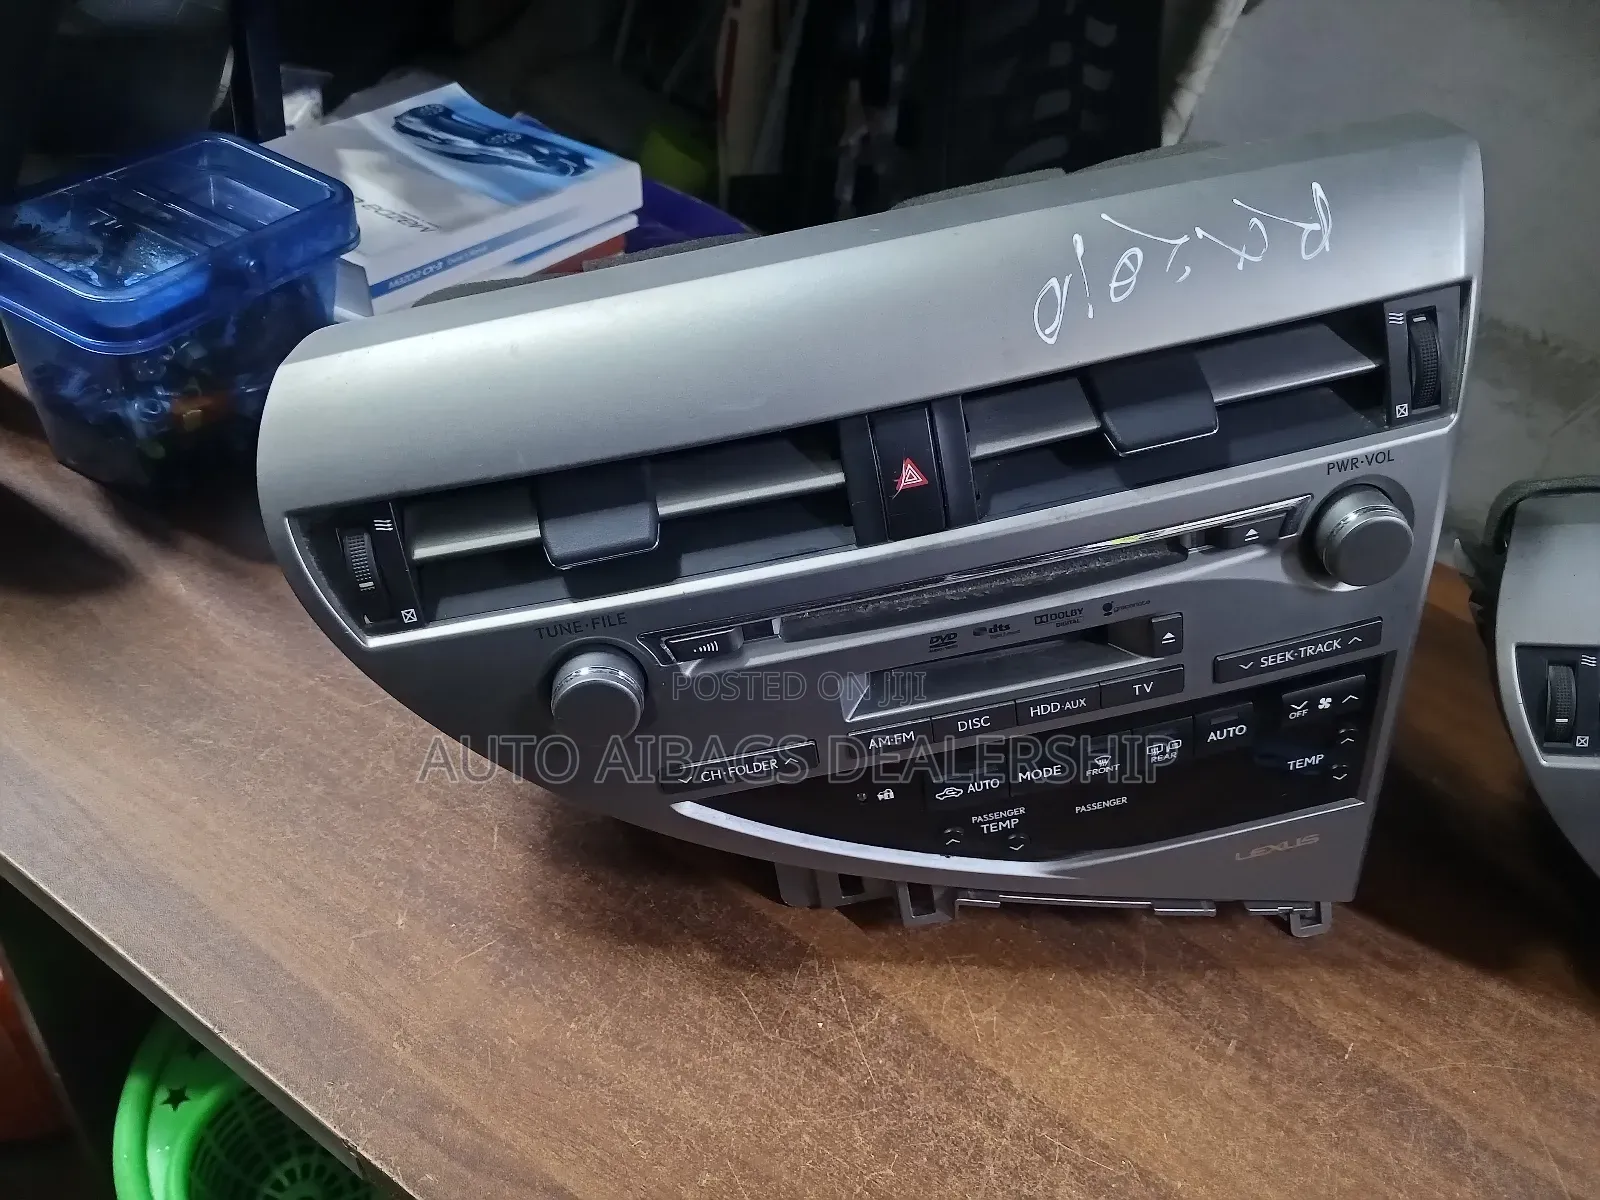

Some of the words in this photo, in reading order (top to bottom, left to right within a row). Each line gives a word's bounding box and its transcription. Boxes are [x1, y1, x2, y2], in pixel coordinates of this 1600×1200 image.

[1050, 607, 1084, 622] DOLBY
[988, 623, 1012, 636] dts
[929, 632, 959, 646] DVD
[1132, 681, 1154, 697] TV
[1288, 708, 1309, 721] OFF
[957, 715, 992, 733] DISC
[1206, 723, 1248, 744] AUTO
[1150, 750, 1178, 765] REAR
[1287, 753, 1325, 772] TEMP
[1018, 764, 1063, 784] MODE
[1085, 763, 1121, 778] FRONT
[966, 777, 1001, 795] AUTO
[1075, 796, 1129, 815] PASSENGER
[971, 806, 1026, 825] PASSENGER
[980, 817, 1020, 835] TEMP
[1234, 833, 1321, 862] LEXUS
